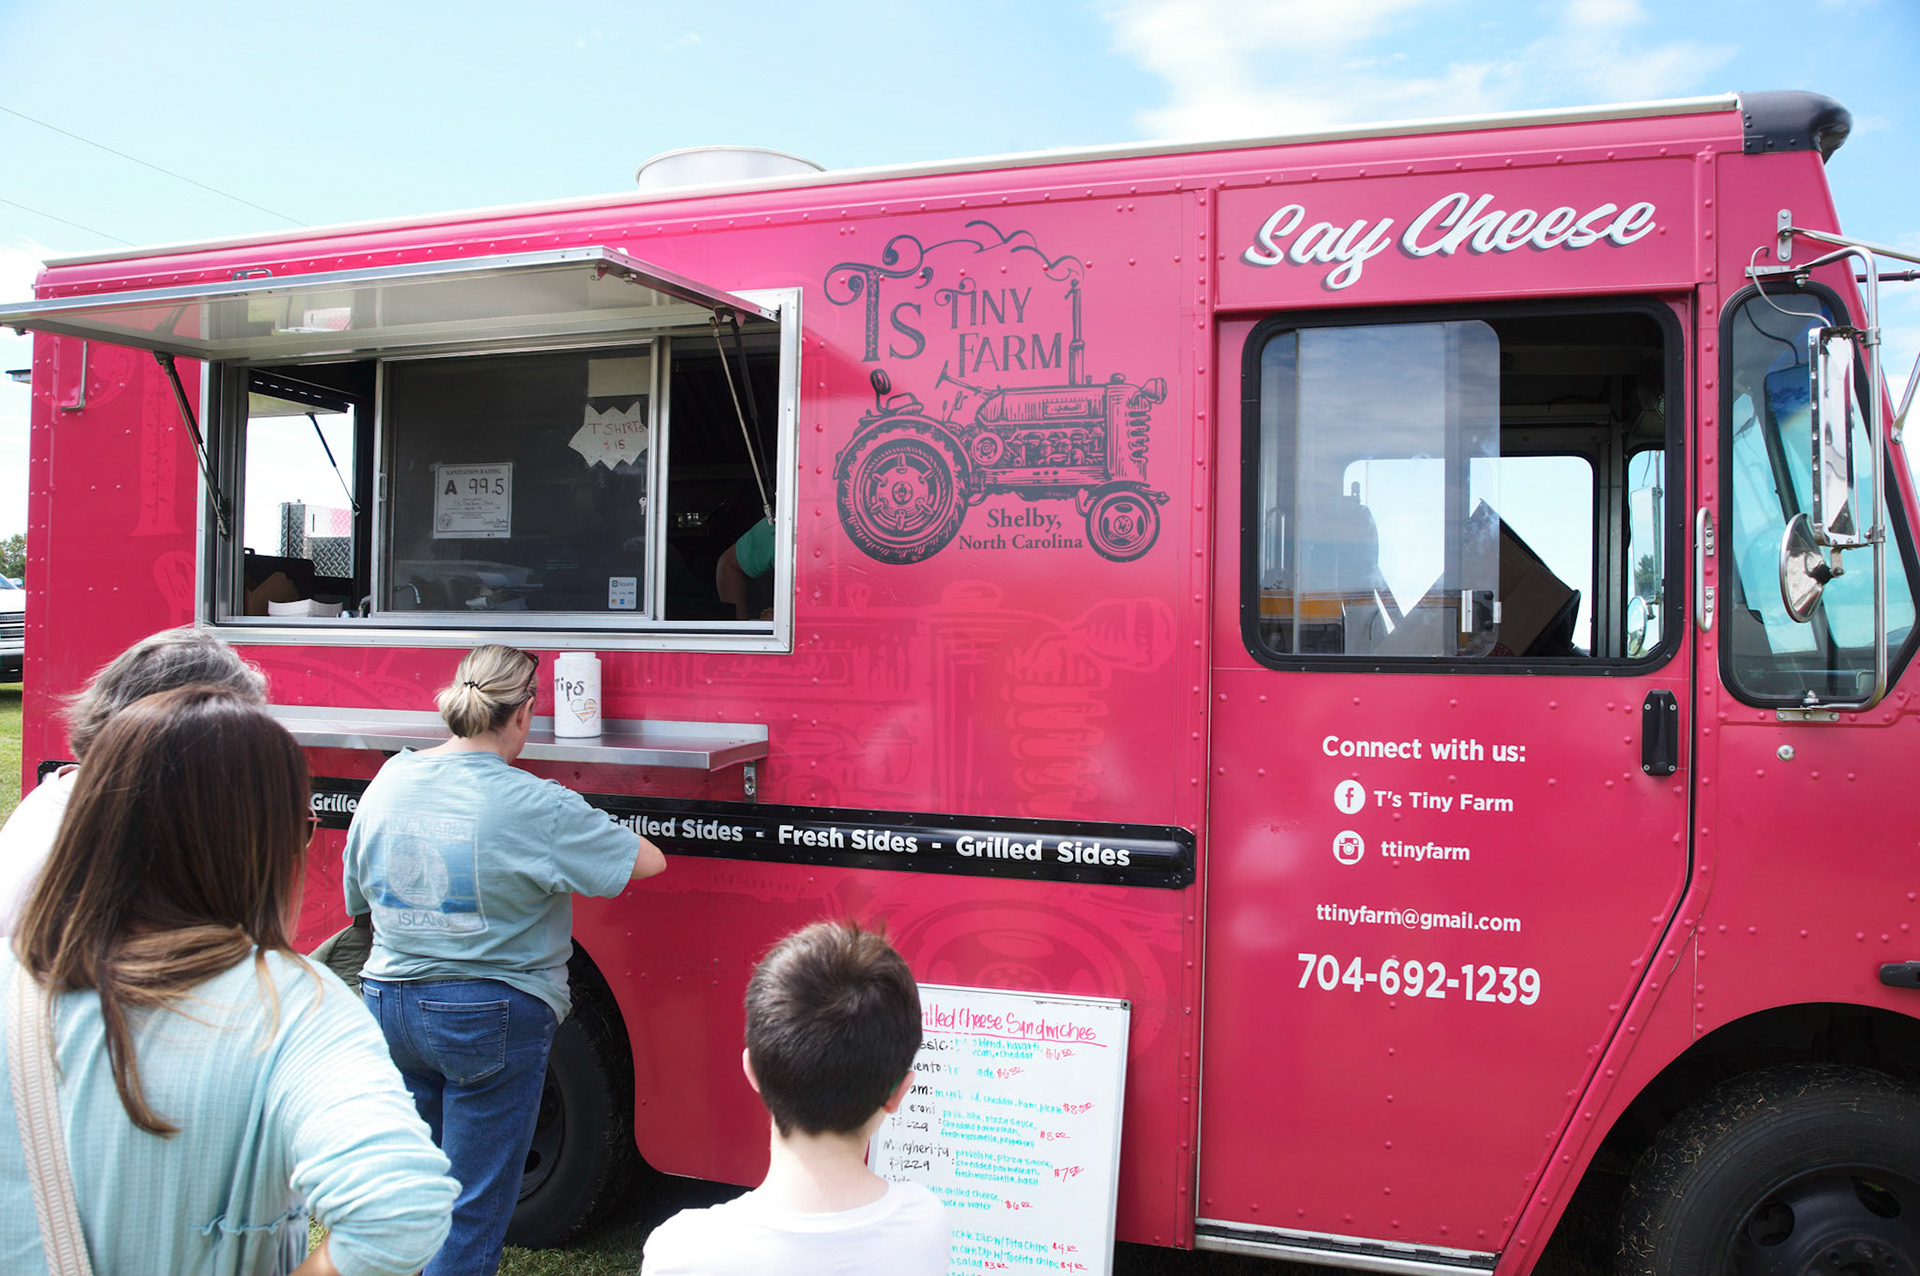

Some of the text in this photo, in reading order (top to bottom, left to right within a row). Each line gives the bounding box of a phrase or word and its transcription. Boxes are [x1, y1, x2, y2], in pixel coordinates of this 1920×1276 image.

[1243, 192, 1656, 292] Say Cheese
[445, 477, 504, 495] A 99.5
[987, 508, 1062, 531] Shelby,
[959, 534, 1083, 550] North Carolina
[1322, 735, 1526, 763] Connect with us:
[310, 793, 357, 813] Grille
[1373, 790, 1402, 807] T's
[1409, 792, 1453, 812] Tiny
[1460, 794, 1514, 812] Farm
[682, 819, 744, 842] Sides
[778, 825, 844, 849] Fresh
[851, 829, 918, 853] Sides
[956, 835, 1042, 861] Grilled
[1057, 841, 1130, 867] Sides
[1381, 841, 1470, 861] ttinyfarm
[1316, 904, 1522, 932] ttinyfarm@gmail.com
[1298, 952, 1541, 1005] 704-692-1239
[921, 1004, 956, 1029] rilled
[959, 1008, 1003, 1030] Cheese
[919, 1038, 953, 1051] ssic:
[910, 1084, 933, 1095] am:
[883, 1139, 949, 1157] Mrgherita
